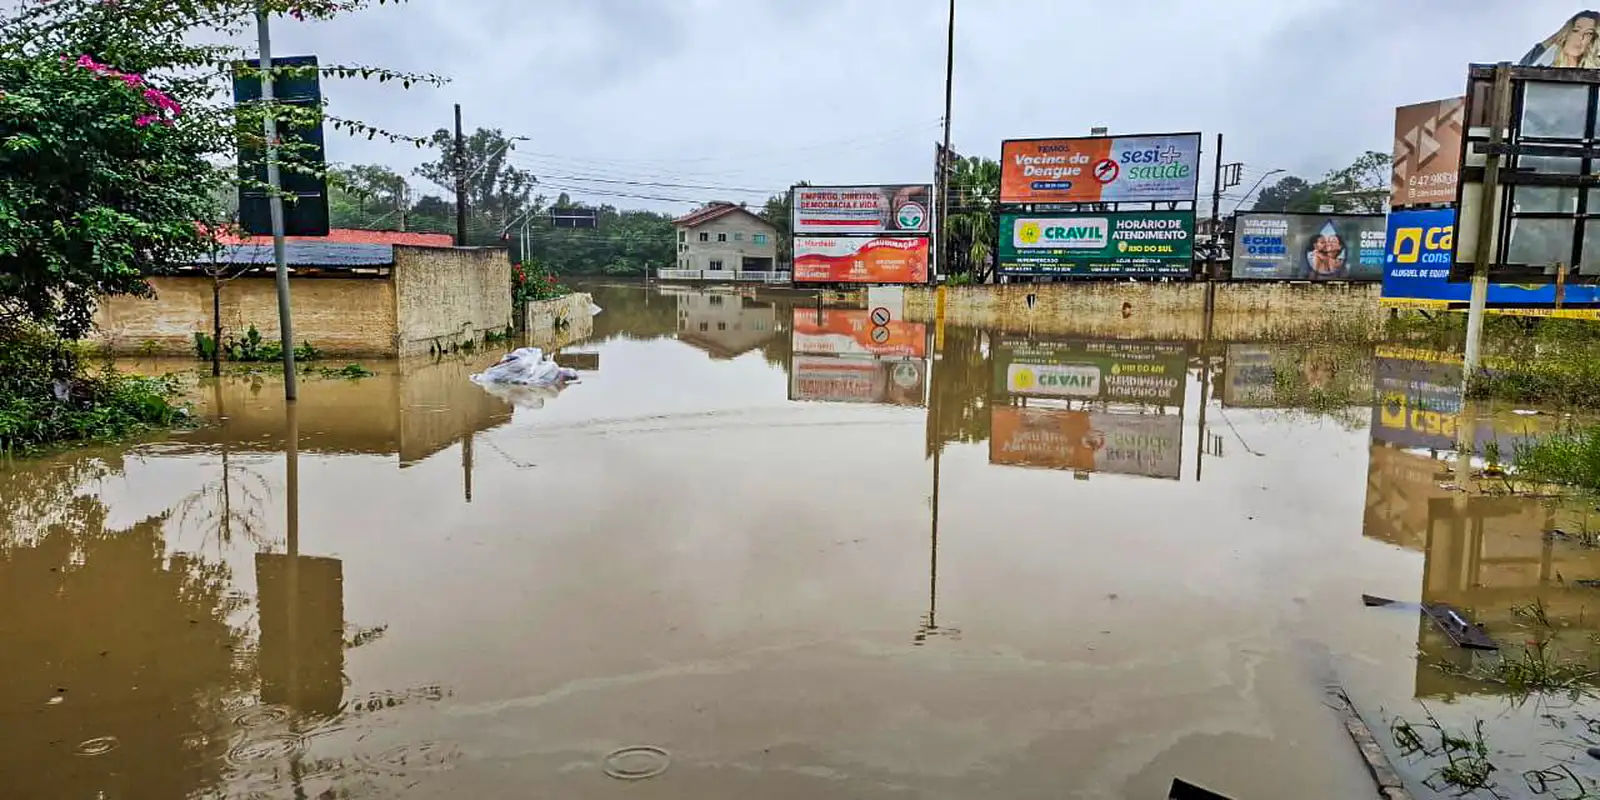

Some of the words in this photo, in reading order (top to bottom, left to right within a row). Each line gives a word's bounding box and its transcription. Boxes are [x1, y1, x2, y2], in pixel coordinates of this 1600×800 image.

[1015, 153, 1065, 165] Vacina
[1069, 152, 1090, 164] da
[1024, 165, 1081, 179] Dengue
[1128, 160, 1189, 179] saúde
[1116, 218, 1167, 229] HORÁRIO
[1168, 219, 1182, 229] DE
[1244, 219, 1288, 227] VACINA
[1044, 226, 1103, 239] CRAVIL
[1111, 230, 1187, 240] ATENDIMENTO
[1157, 245, 1173, 253] SUL
[1391, 269, 1418, 277] ALUGUEL
[1419, 269, 1427, 277] DE
